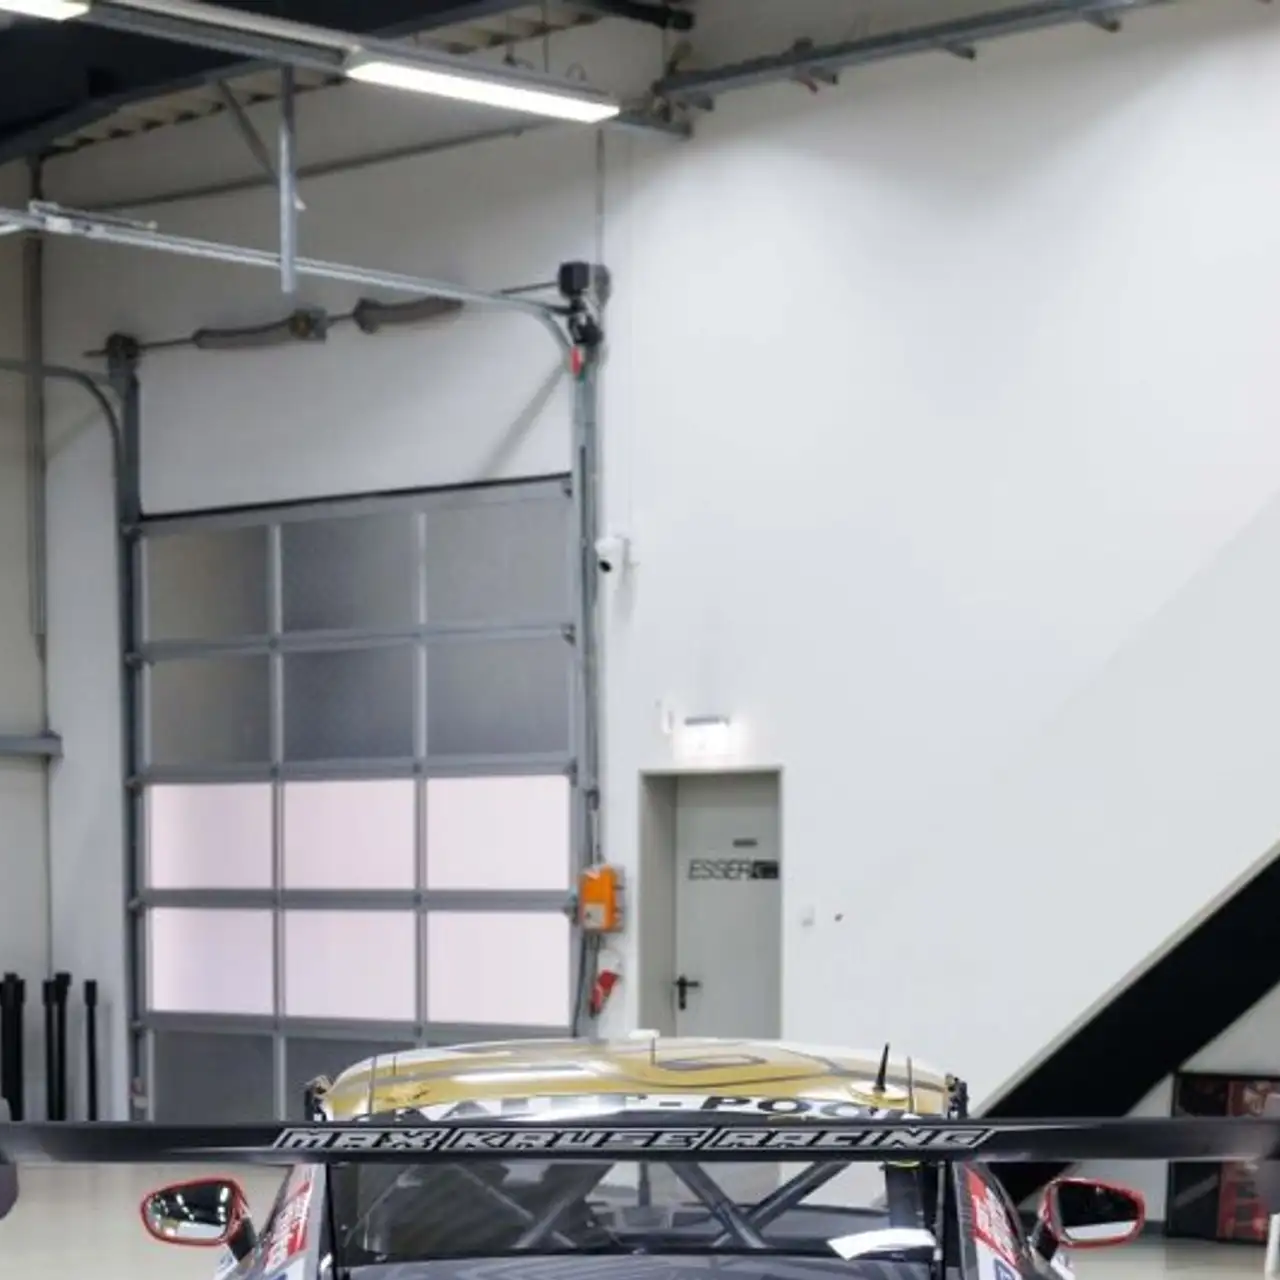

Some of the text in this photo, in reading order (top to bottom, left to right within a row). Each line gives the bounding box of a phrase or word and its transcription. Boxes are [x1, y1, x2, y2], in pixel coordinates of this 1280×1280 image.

[689, 859, 752, 880] ESSER
[275, 1130, 990, 1149] MAX KRUSE RACING
